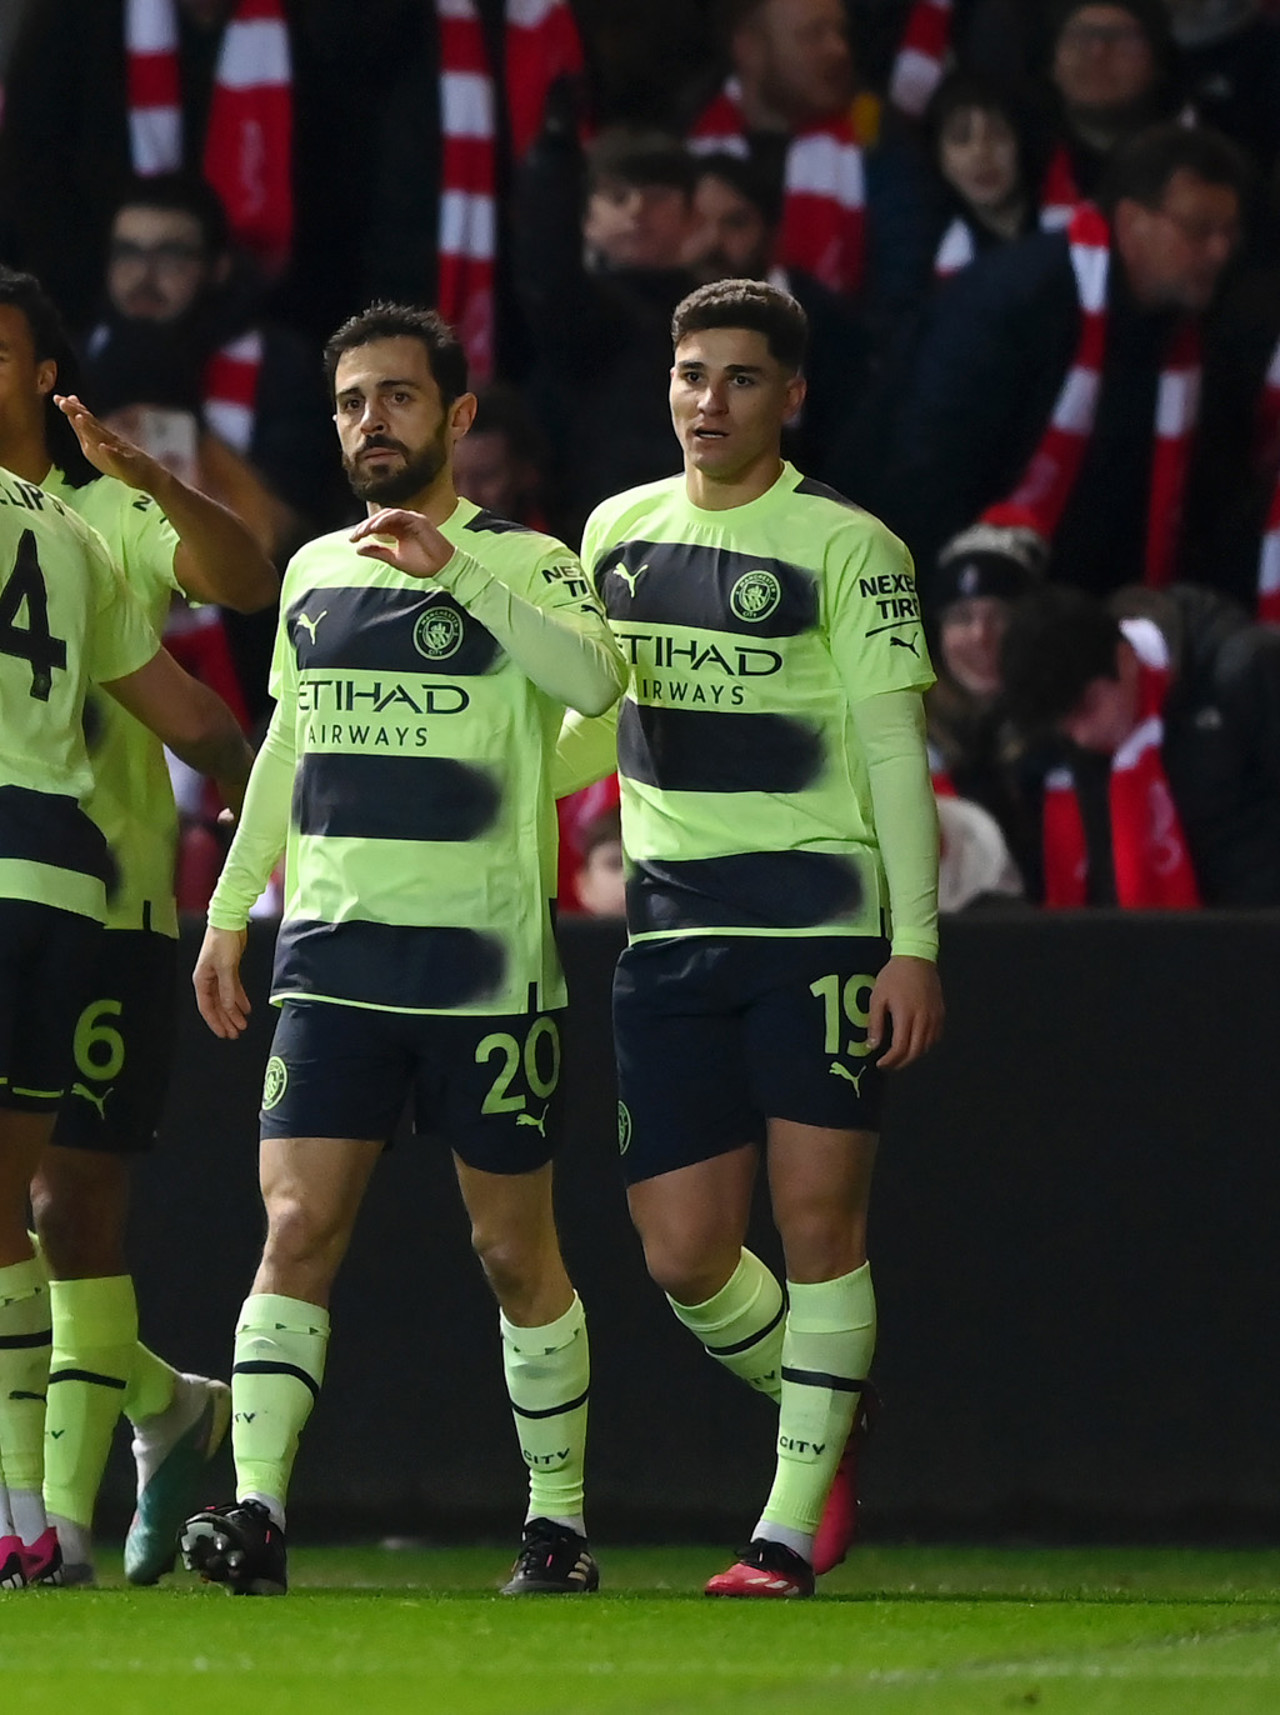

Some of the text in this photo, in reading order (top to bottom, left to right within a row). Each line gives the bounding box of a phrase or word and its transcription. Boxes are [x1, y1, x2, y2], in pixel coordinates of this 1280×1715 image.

[859, 574, 916, 598] NEXE
[298, 680, 470, 715] ETIHAD
[643, 679, 745, 706] IRWAYS
[308, 724, 428, 747] AIRWAYS
[809, 974, 877, 1057] 19
[73, 999, 125, 1080] 6
[475, 1016, 561, 1115] 20
[523, 1447, 570, 1465] CITY
[779, 1435, 826, 1455] CITY
